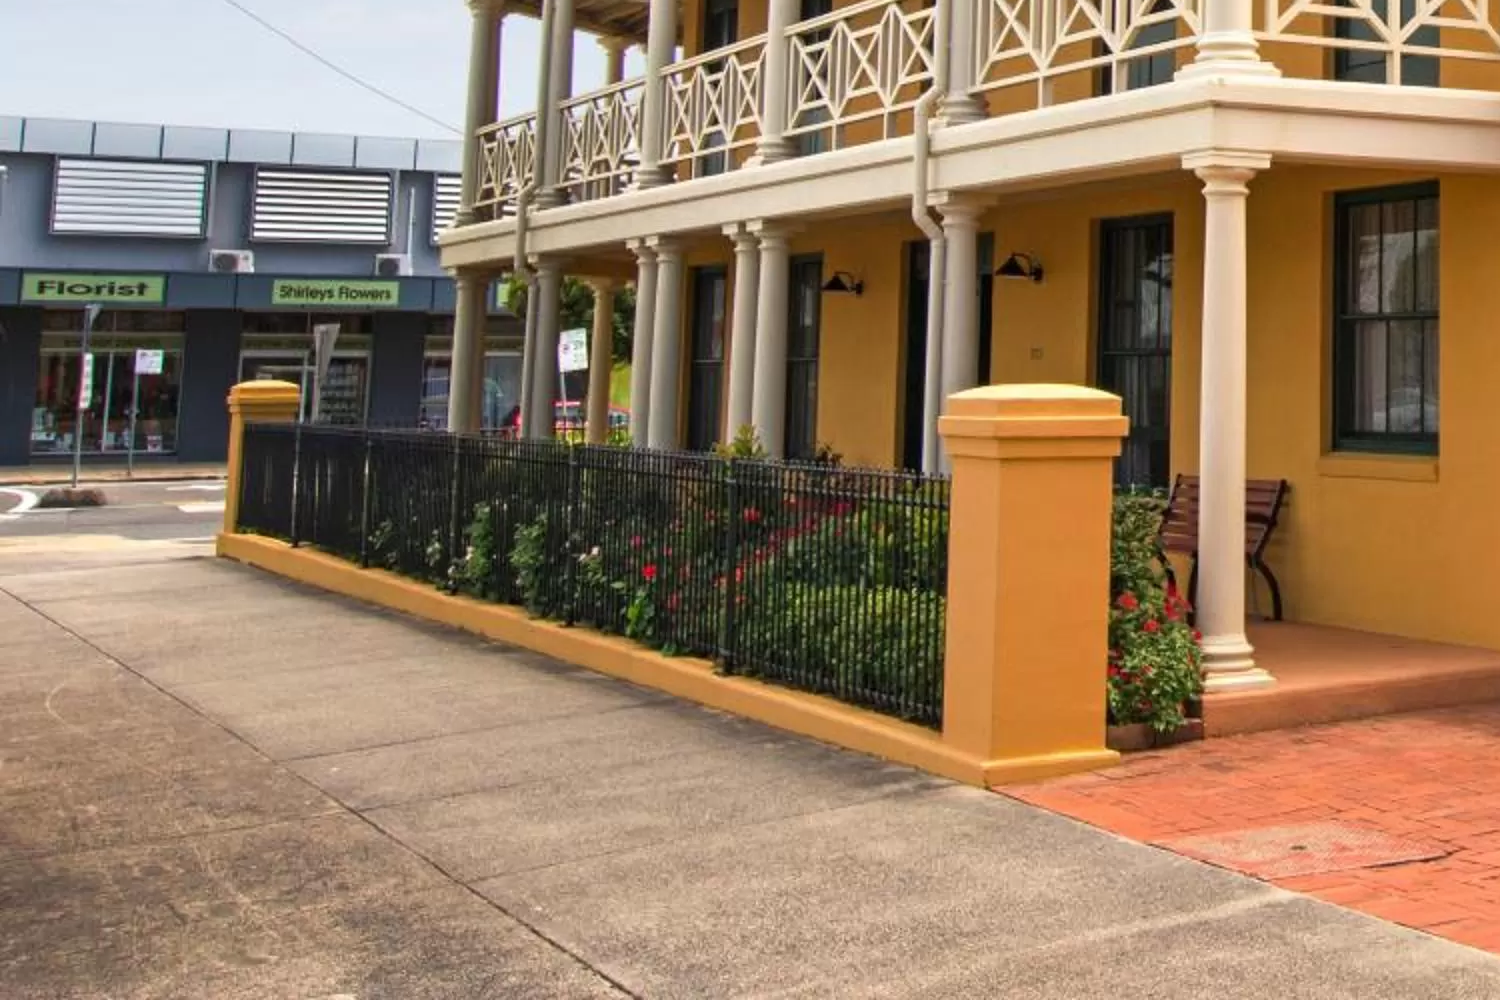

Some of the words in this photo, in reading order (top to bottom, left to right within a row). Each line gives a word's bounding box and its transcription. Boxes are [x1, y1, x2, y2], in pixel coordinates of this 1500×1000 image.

[37, 280, 149, 297] Florist
[279, 285, 334, 301] Shirleys
[338, 286, 391, 300] Flowers
